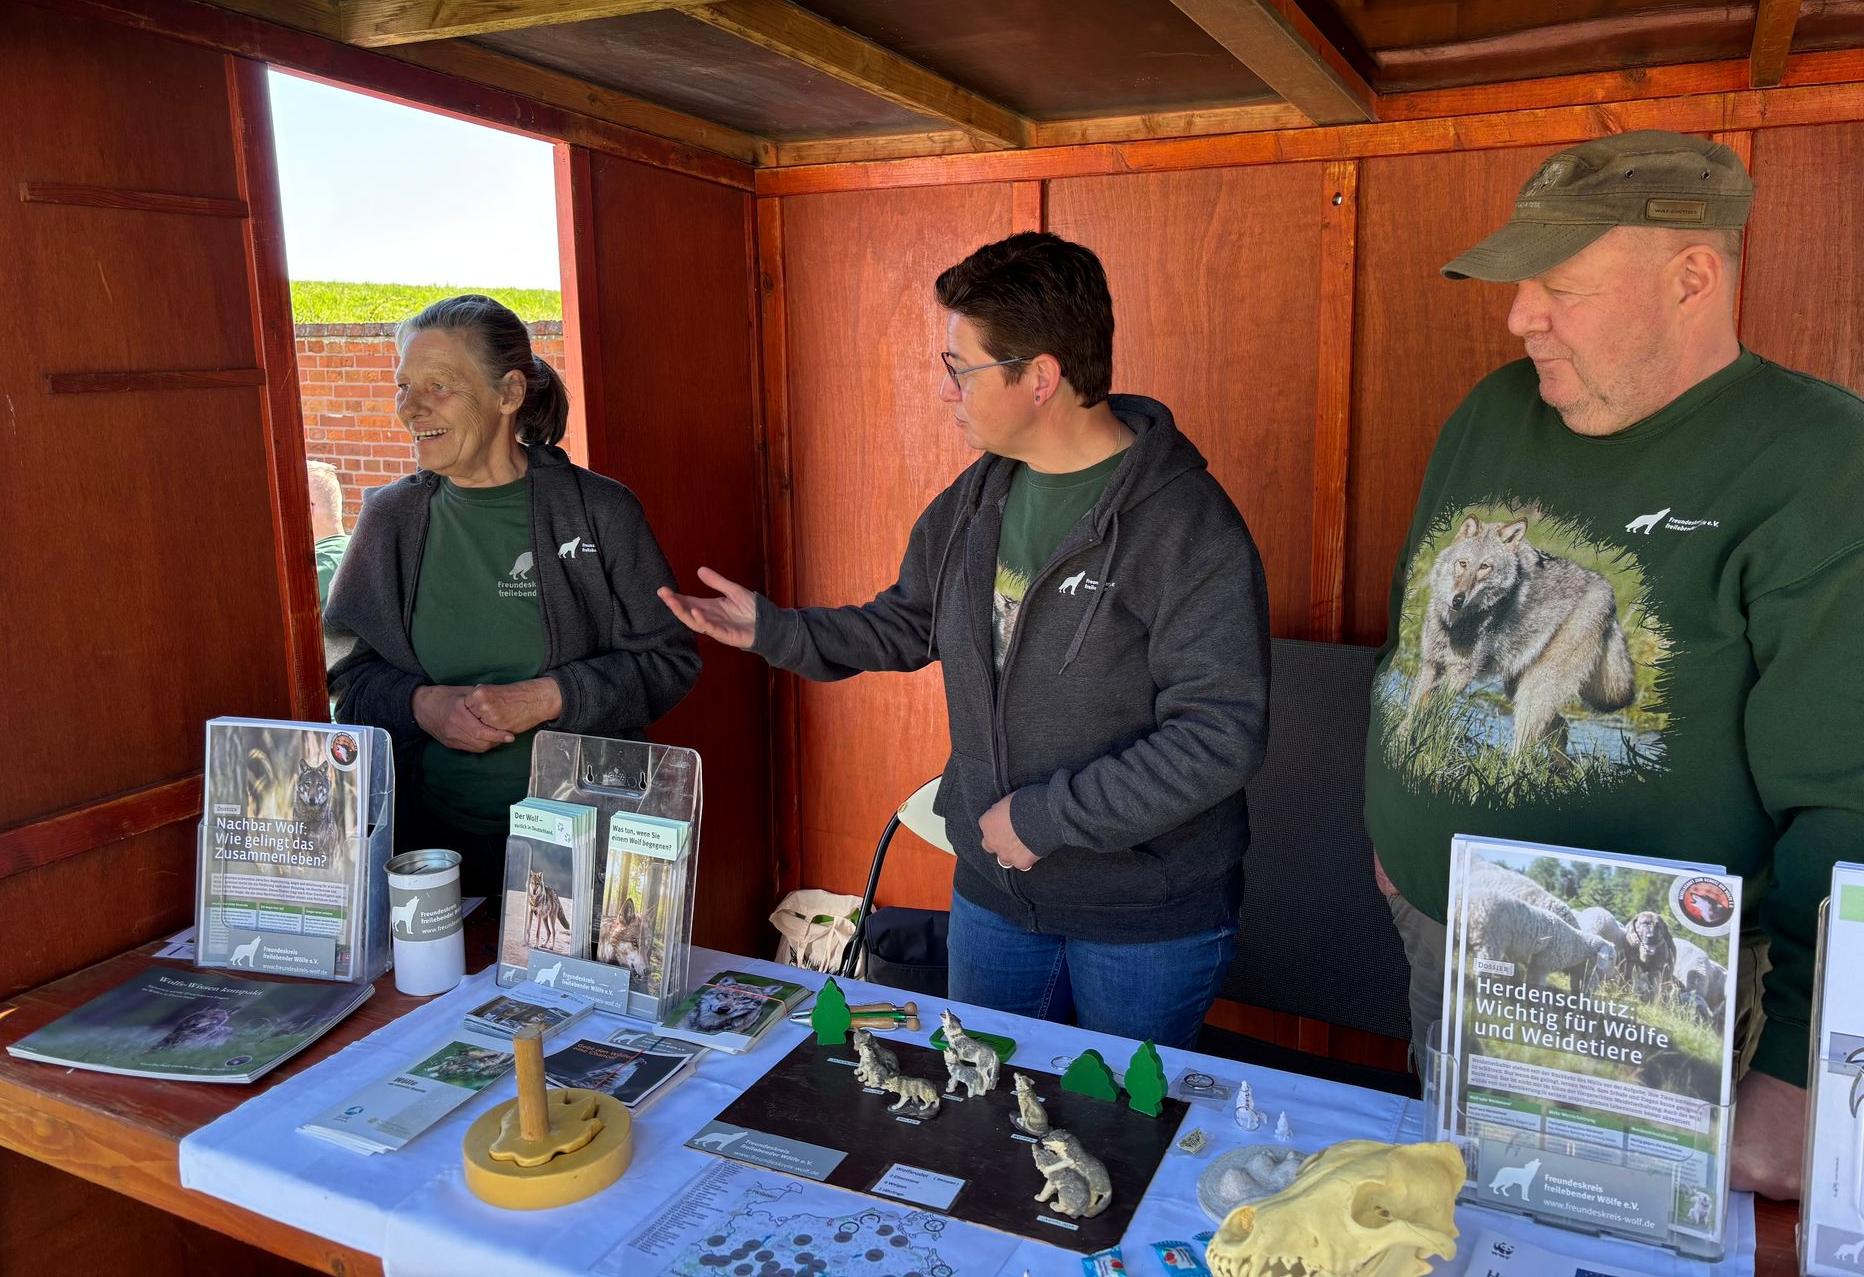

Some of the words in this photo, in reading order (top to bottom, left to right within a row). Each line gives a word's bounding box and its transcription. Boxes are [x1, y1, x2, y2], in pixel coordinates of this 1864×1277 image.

[497, 580, 537, 588] Freundesk
[499, 589, 537, 597] freilebend
[217, 817, 272, 832] Nachbar
[275, 821, 307, 835] Wolf:
[514, 812, 525, 820] Der
[525, 813, 539, 822] Wolf
[215, 832, 242, 845] Wie
[245, 835, 289, 851] gelingt
[292, 837, 314, 850] das
[613, 824, 624, 833] Was
[624, 827, 636, 836] tun,
[636, 830, 650, 838] wenn
[651, 831, 661, 840] Sie
[611, 834, 629, 843] einem
[629, 837, 642, 846] Wolf
[642, 839, 672, 851] begegnen?
[214, 847, 327, 866] Zusammenleben?
[263, 946, 298, 955] Freundeskreis
[1477, 977, 1636, 1020] Herdenschutz:
[1475, 998, 1558, 1031] Wichtig
[1565, 1011, 1597, 1034] für
[1604, 1019, 1668, 1048] Wölfe
[1475, 1020, 1514, 1041] und
[1522, 1027, 1643, 1065] Weidetiere
[1544, 1173, 1603, 1193] Freundeskreis
[1543, 1183, 1596, 1202] freilebender
[1597, 1195, 1622, 1207] Wölfe
[1623, 1202, 1640, 1211] e.V.
[1543, 1199, 1656, 1229] www.freundeskreis-wolf.de
